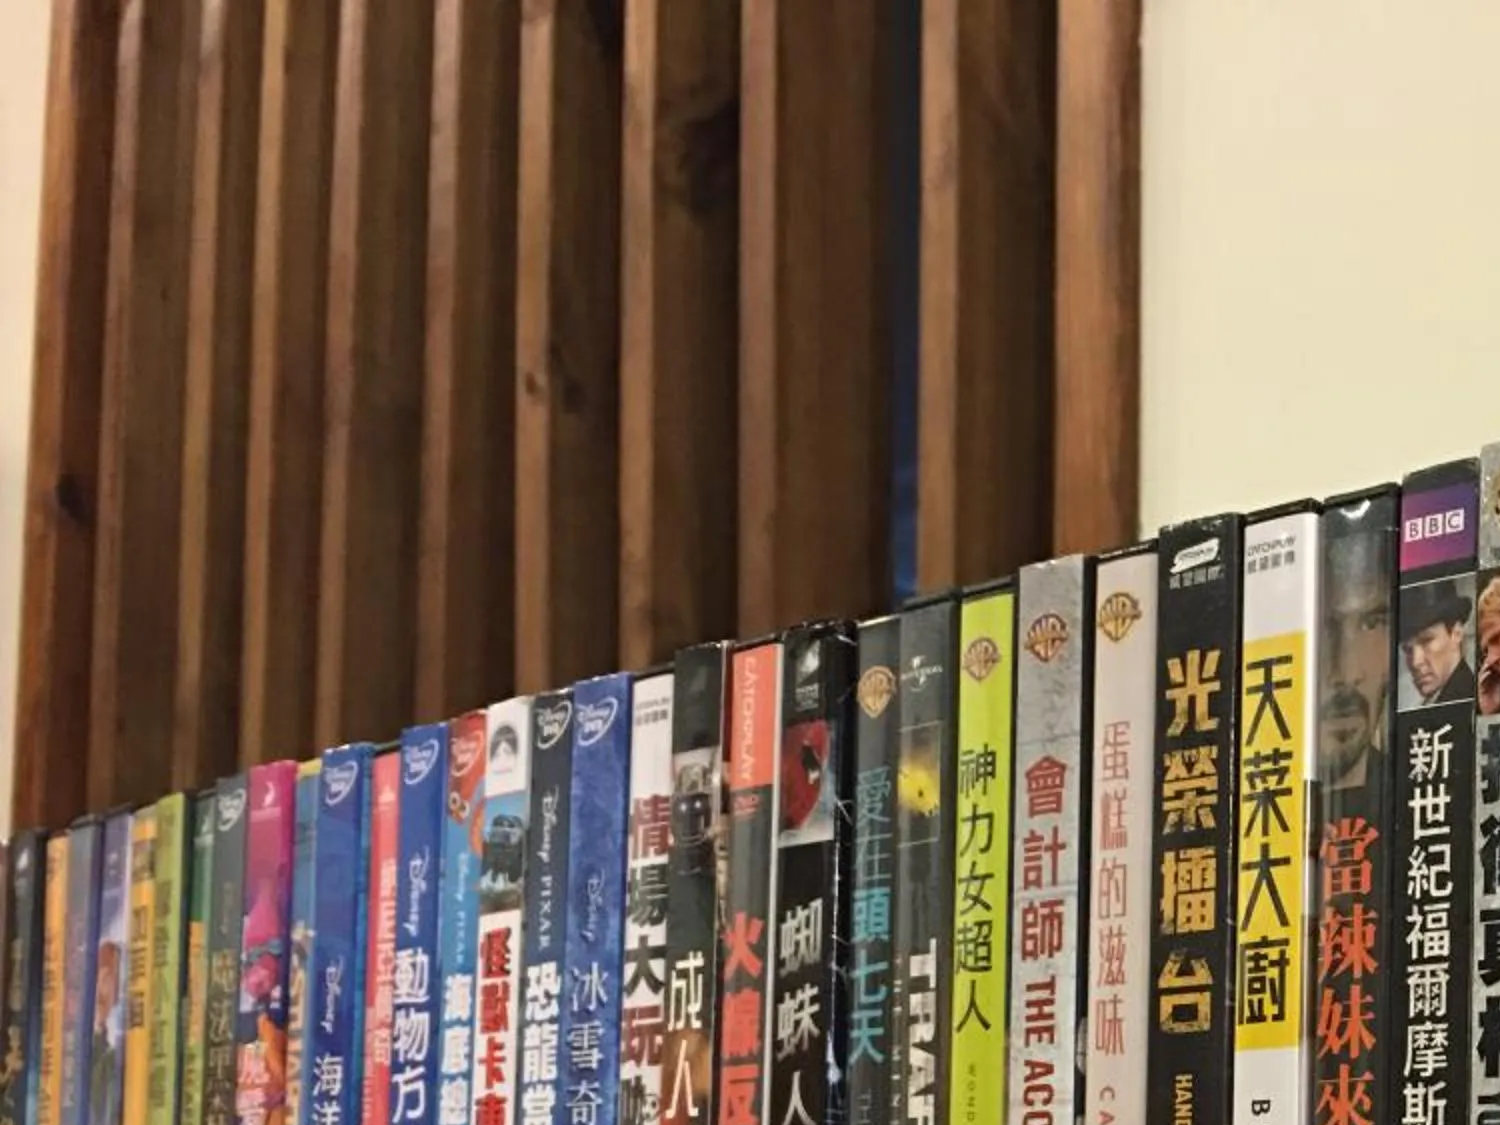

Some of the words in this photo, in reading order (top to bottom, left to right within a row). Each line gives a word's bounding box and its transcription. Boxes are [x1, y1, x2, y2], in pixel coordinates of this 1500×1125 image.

[1404, 508, 1465, 542] BBC
[955, 742, 998, 1035] 神力女超人
[1020, 755, 1068, 961] 會計師
[1093, 720, 1132, 1056] 蛋糕的滋味
[1156, 648, 1222, 1034] 光榮擂台
[1237, 653, 1294, 1026] 天菜大廚
[1024, 975, 1056, 1048] THE
